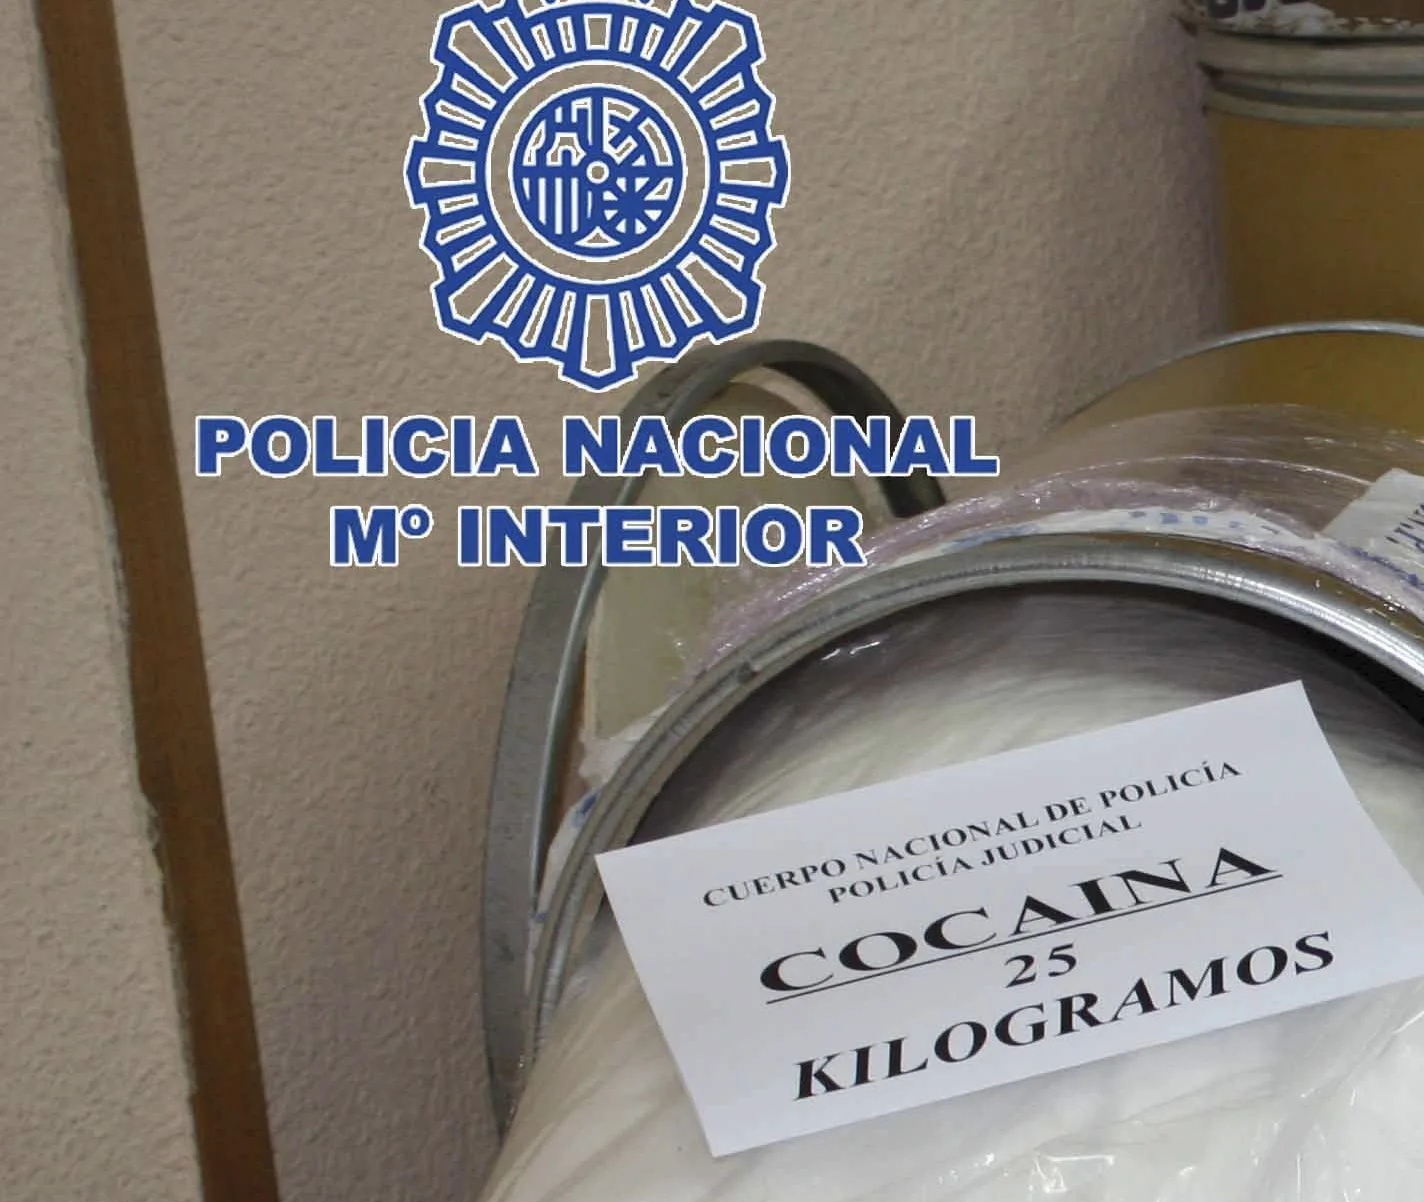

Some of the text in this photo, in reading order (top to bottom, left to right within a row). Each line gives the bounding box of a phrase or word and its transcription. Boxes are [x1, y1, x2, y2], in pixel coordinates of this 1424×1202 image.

[703, 760, 1242, 907] CUERPO NACIONAL DE POLICÍA
[828, 813, 1143, 903] POLICÍA JUDICIAL
[759, 847, 1276, 992] COCAINA
[1005, 943, 1078, 989] 25
[794, 929, 1335, 1101] KILOGRAMOS
